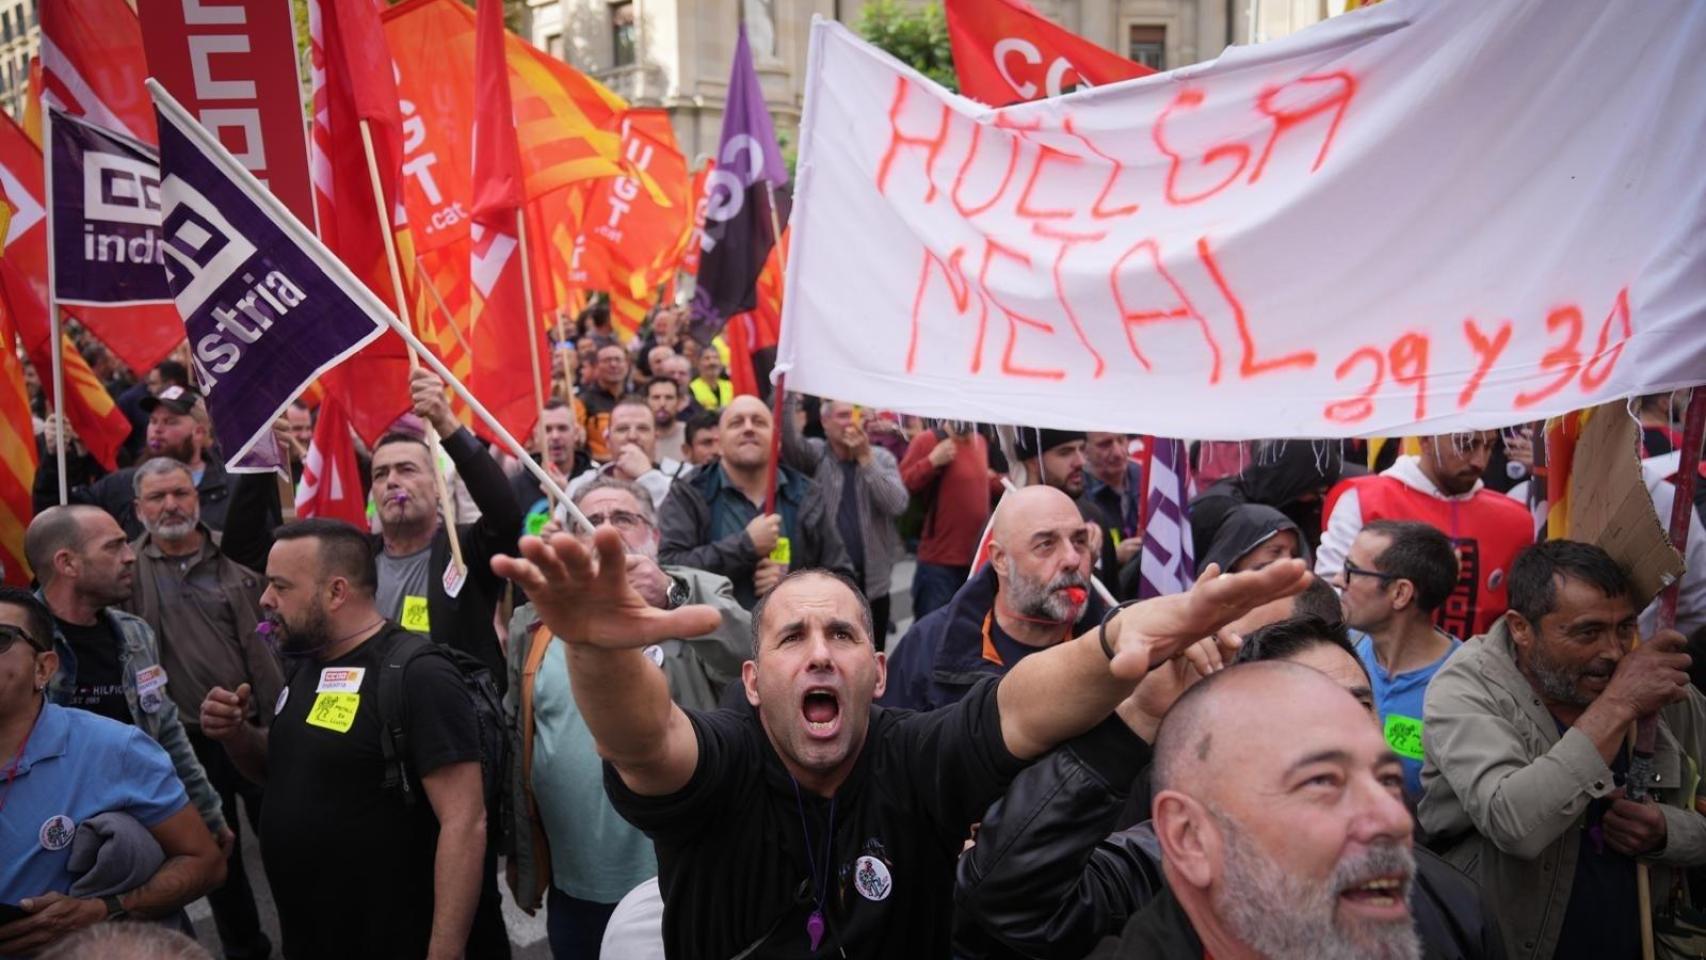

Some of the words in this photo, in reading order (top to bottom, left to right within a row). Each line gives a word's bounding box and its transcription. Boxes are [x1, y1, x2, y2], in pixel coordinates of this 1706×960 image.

[877, 70, 1356, 219] HUELGA
[905, 221, 1317, 385] METAL
[1323, 329, 1430, 424] 29
[1456, 317, 1513, 409] Y
[1513, 285, 1633, 410] 30
